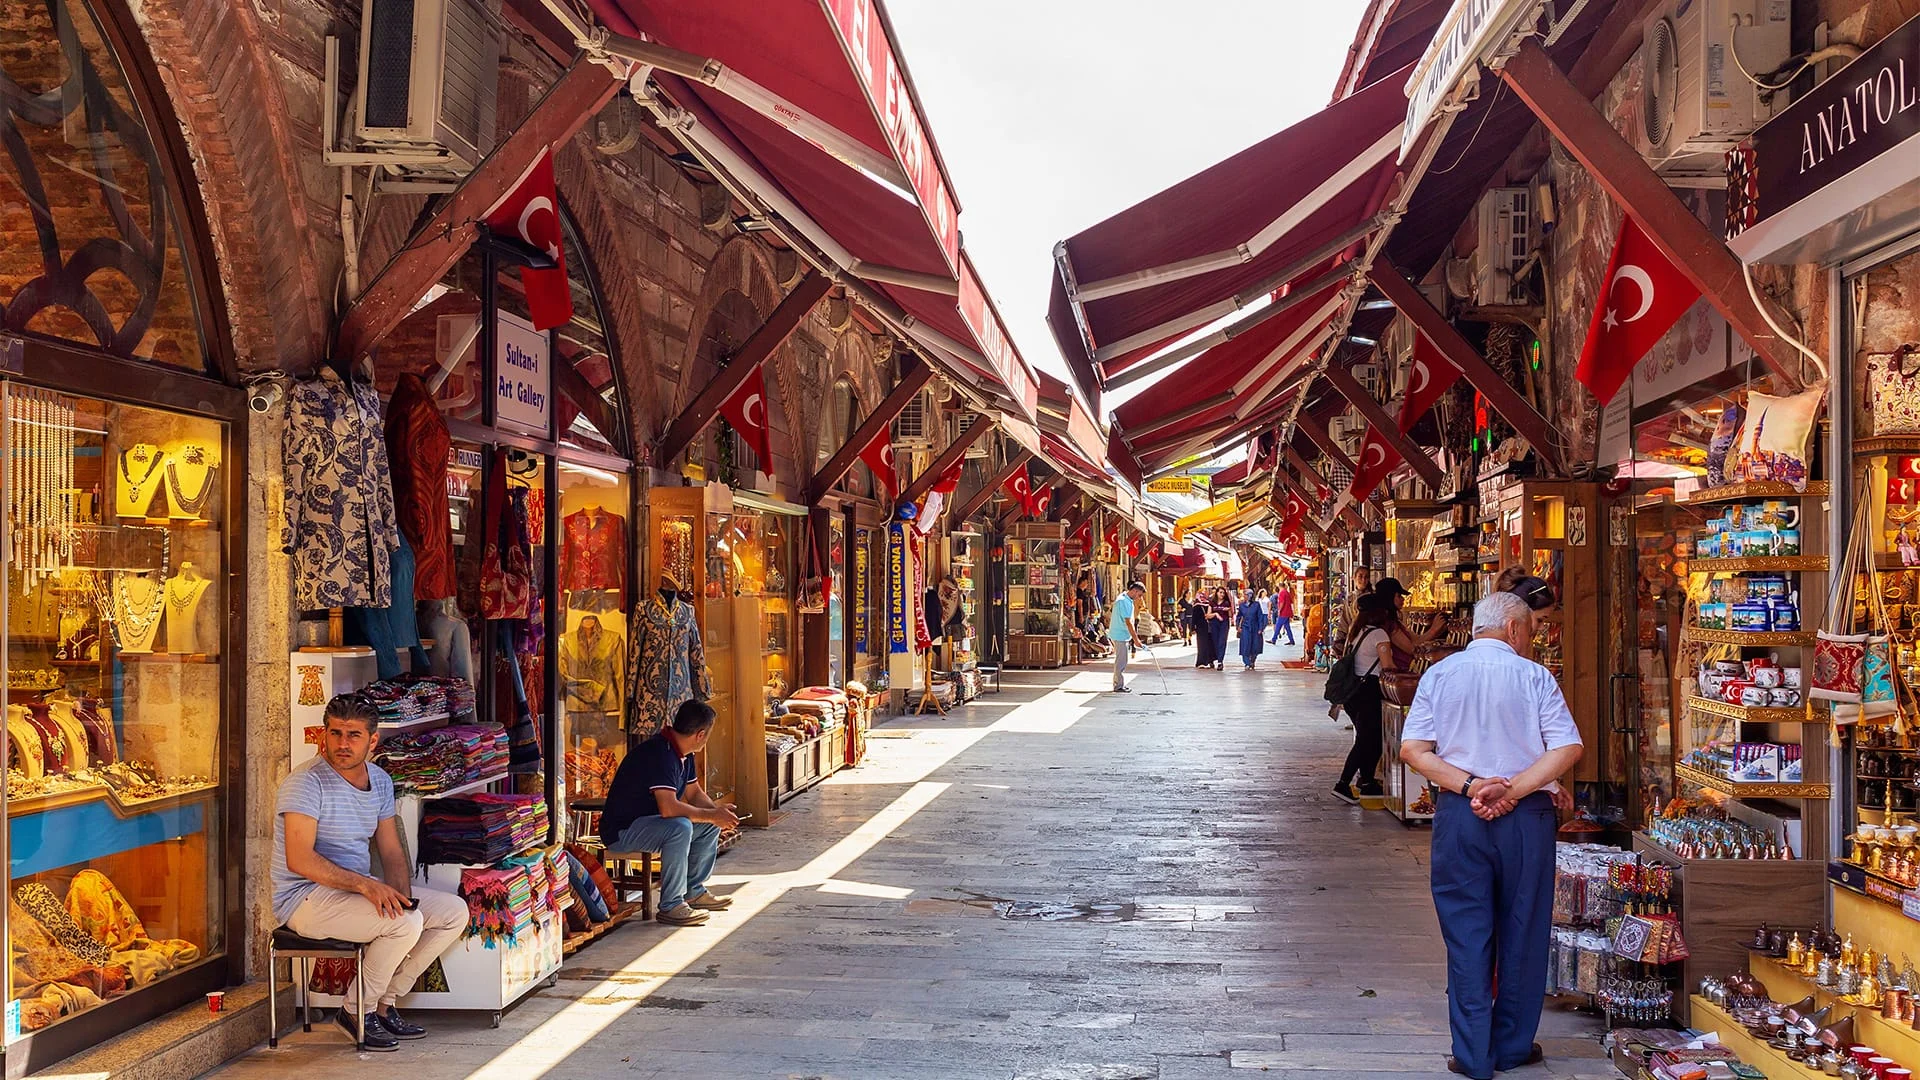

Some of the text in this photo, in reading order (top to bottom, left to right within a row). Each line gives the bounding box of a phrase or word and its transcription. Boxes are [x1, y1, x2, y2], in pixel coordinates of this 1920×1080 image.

[1799, 58, 1920, 174] ANATOL
[506, 342, 538, 373] Sultan-i
[498, 375, 545, 413] Art Gallery
[1155, 481, 1189, 490] MOSAIC MUSEUM
[892, 546, 902, 630] FC BARCELONA
